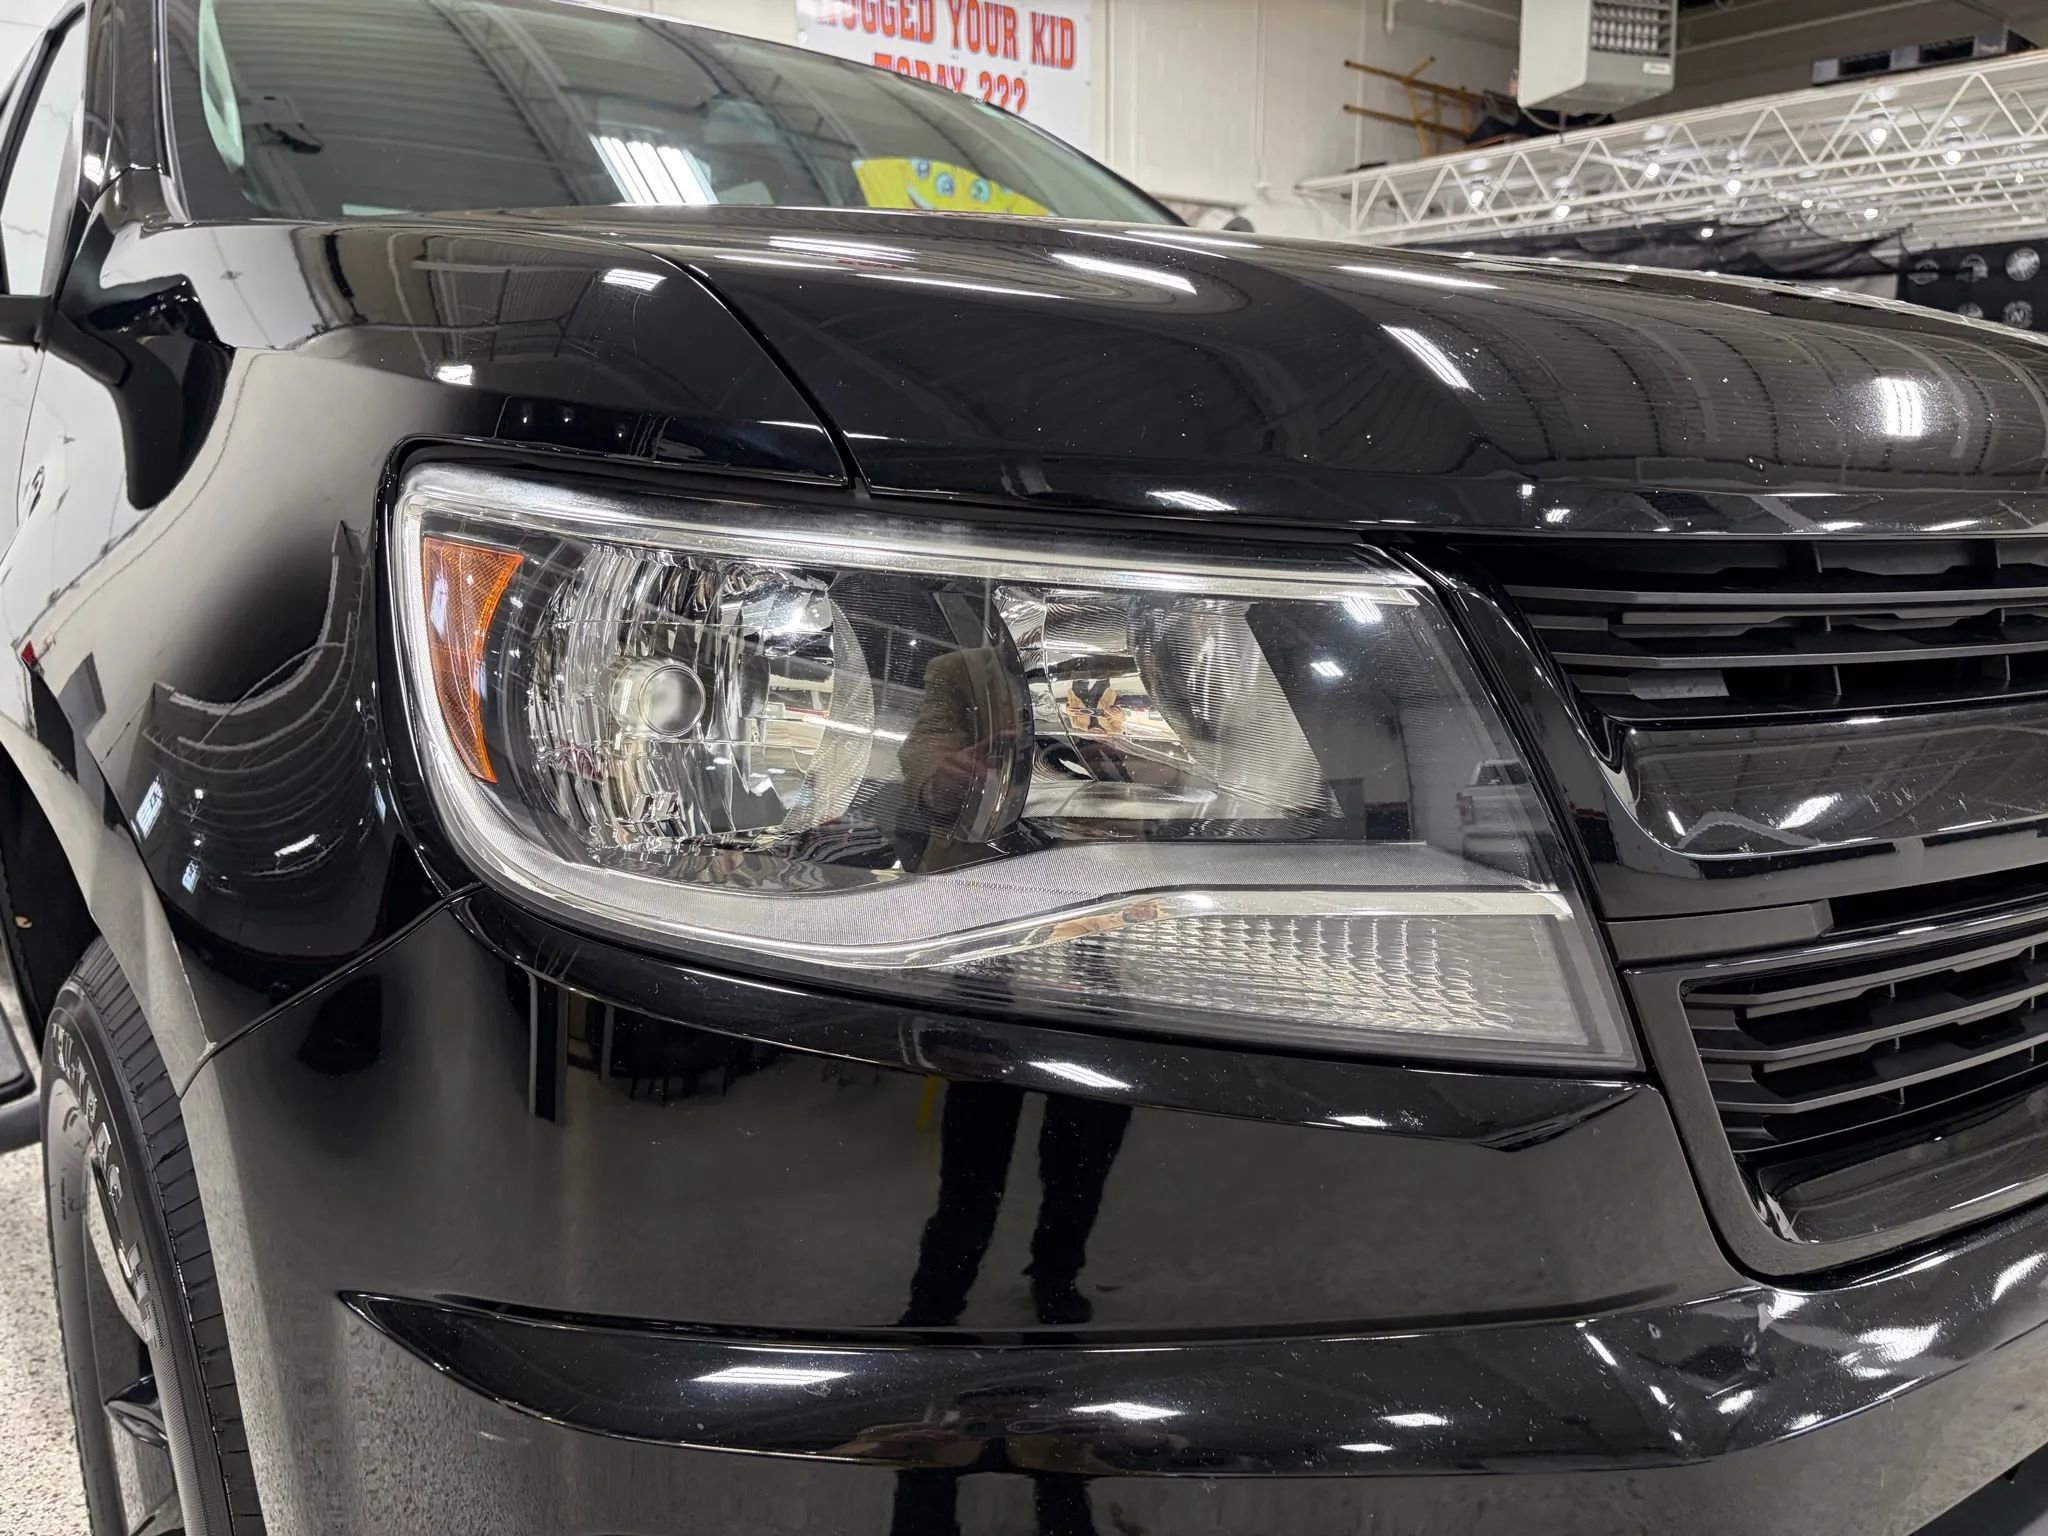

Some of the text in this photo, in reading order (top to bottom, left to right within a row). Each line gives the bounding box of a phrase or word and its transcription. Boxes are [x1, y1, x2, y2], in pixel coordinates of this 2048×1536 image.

[816, 0, 1075, 70] UGGED YOUR KID
